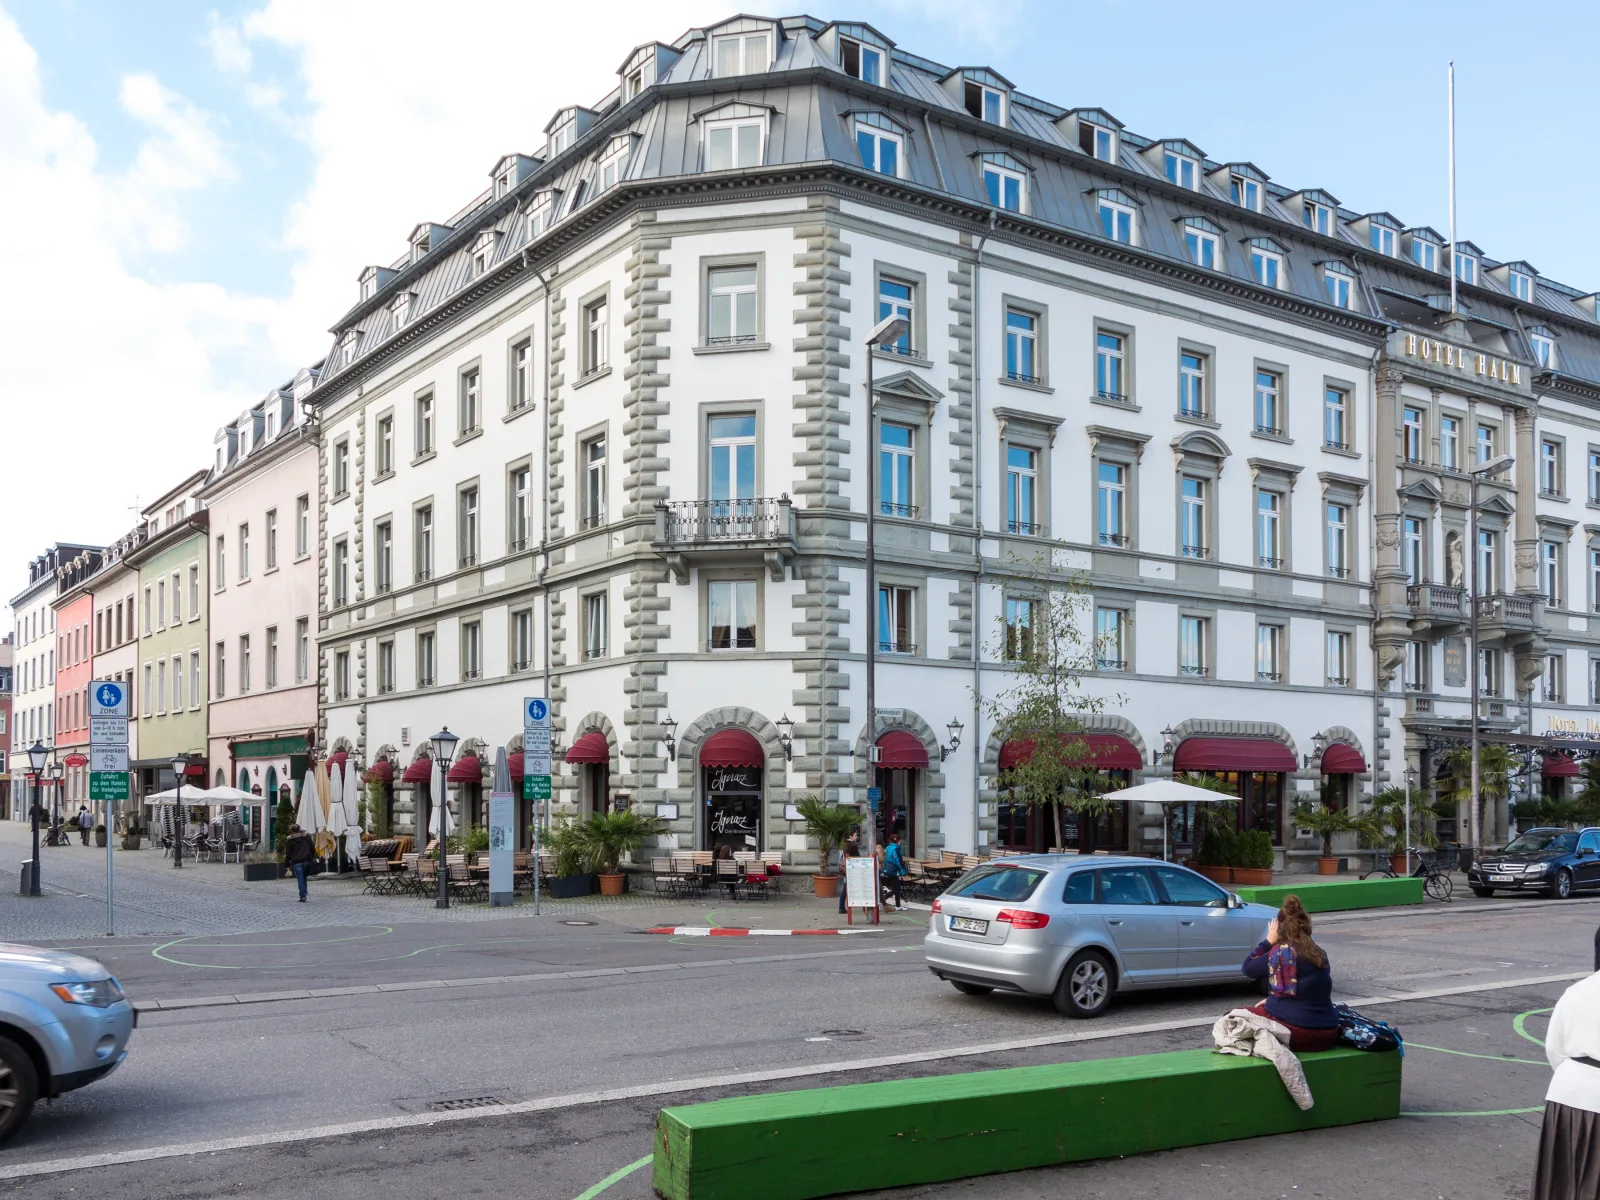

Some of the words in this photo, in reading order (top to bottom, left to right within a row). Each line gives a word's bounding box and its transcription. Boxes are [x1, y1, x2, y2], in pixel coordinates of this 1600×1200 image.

[1406, 335, 1464, 369] HOTEL
[1476, 355, 1521, 385] HALM
[100, 786, 127, 794] Hotelgäste
